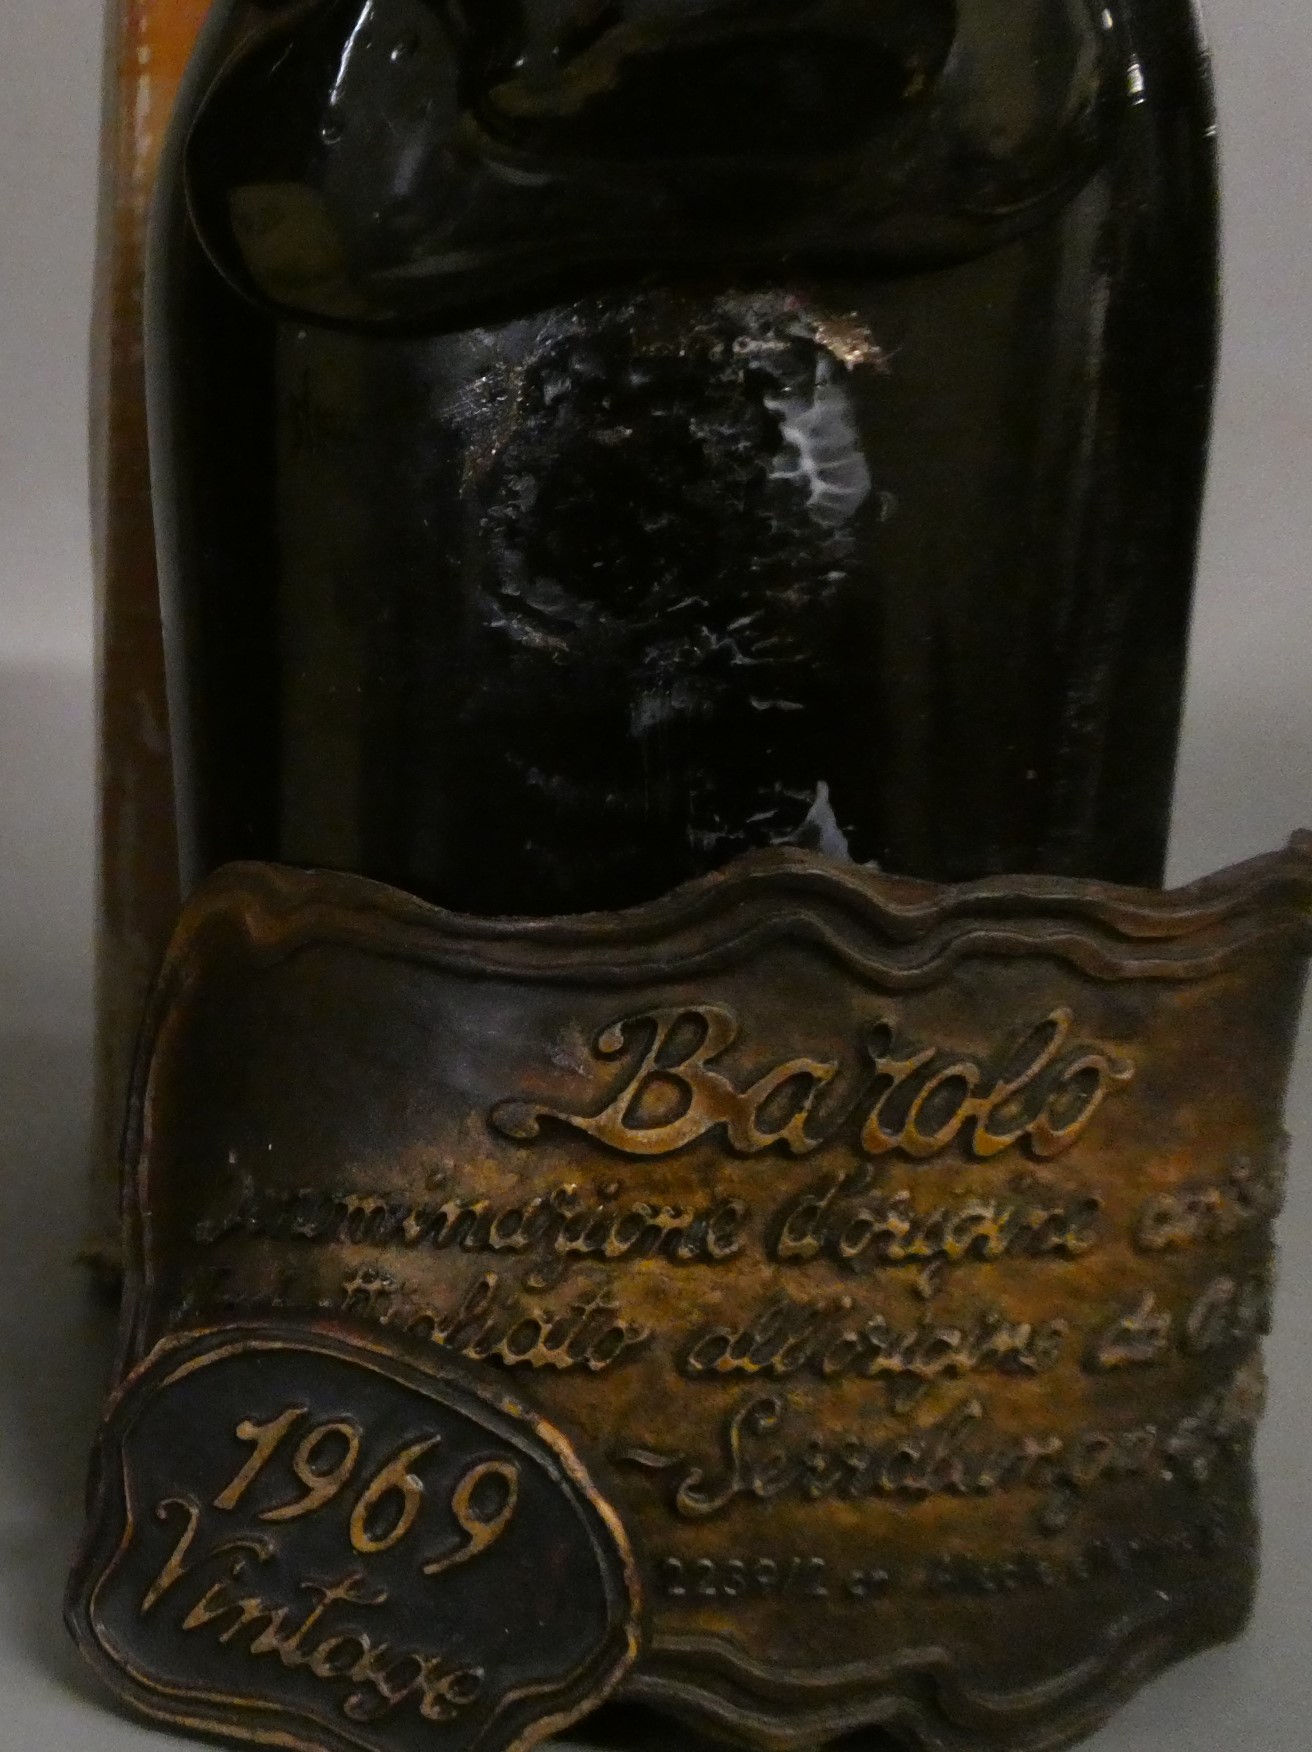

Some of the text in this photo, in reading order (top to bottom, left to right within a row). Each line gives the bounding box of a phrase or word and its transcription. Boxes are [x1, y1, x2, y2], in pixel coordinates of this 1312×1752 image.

[490, 1000, 1136, 1160] Barolo
[212, 1400, 520, 1575] 1969
[140, 1498, 486, 1724] Vintage
